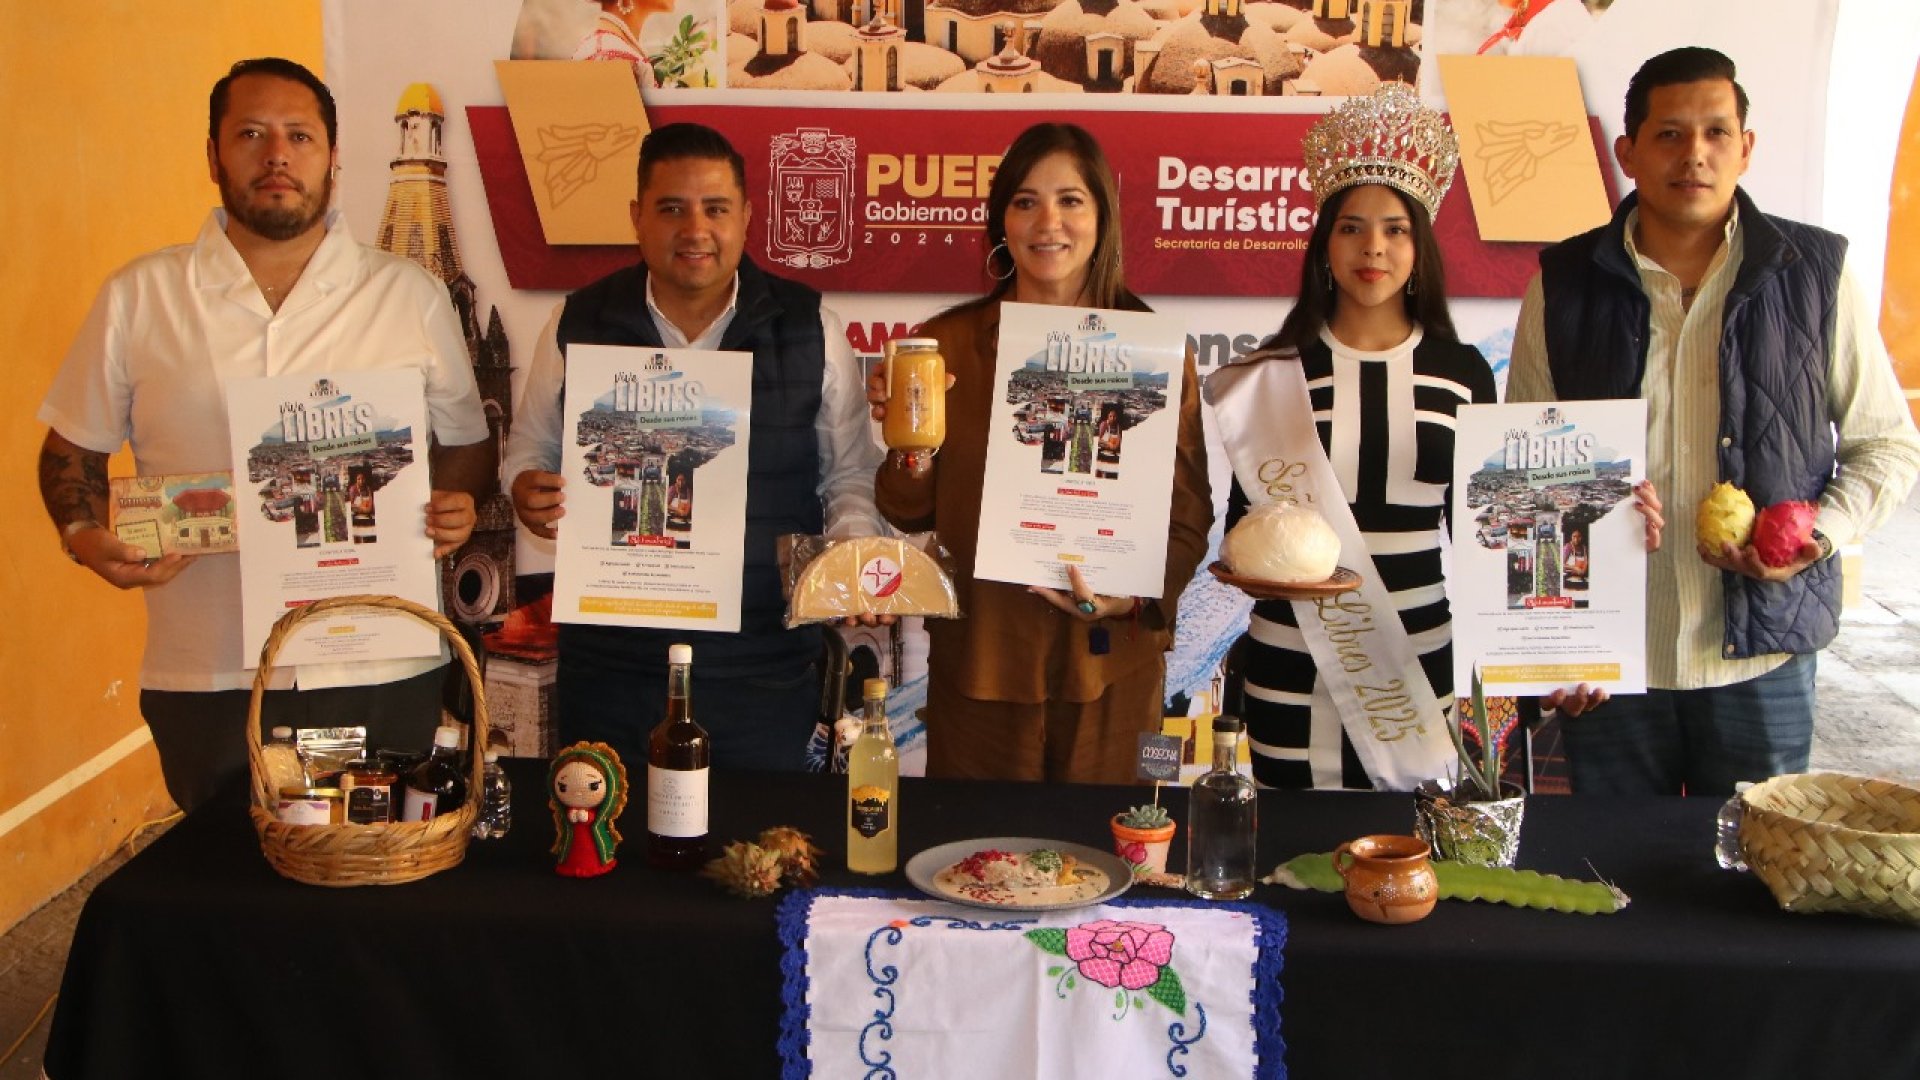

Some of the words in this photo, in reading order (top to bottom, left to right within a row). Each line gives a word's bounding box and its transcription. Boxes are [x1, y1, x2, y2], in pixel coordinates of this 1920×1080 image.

[865, 200, 967, 222] Gobierno
[971, 202, 990, 222] d
[1156, 196, 1318, 232] Turístic
[1154, 237, 1220, 250] Secretaría
[1223, 238, 1240, 250] de
[1047, 340, 1132, 373] LIBRES
[615, 381, 700, 412] LIBRES
[283, 403, 372, 442] LIBRES
[1505, 432, 1596, 470] LIBRES
[1353, 678, 1427, 743] 2025
